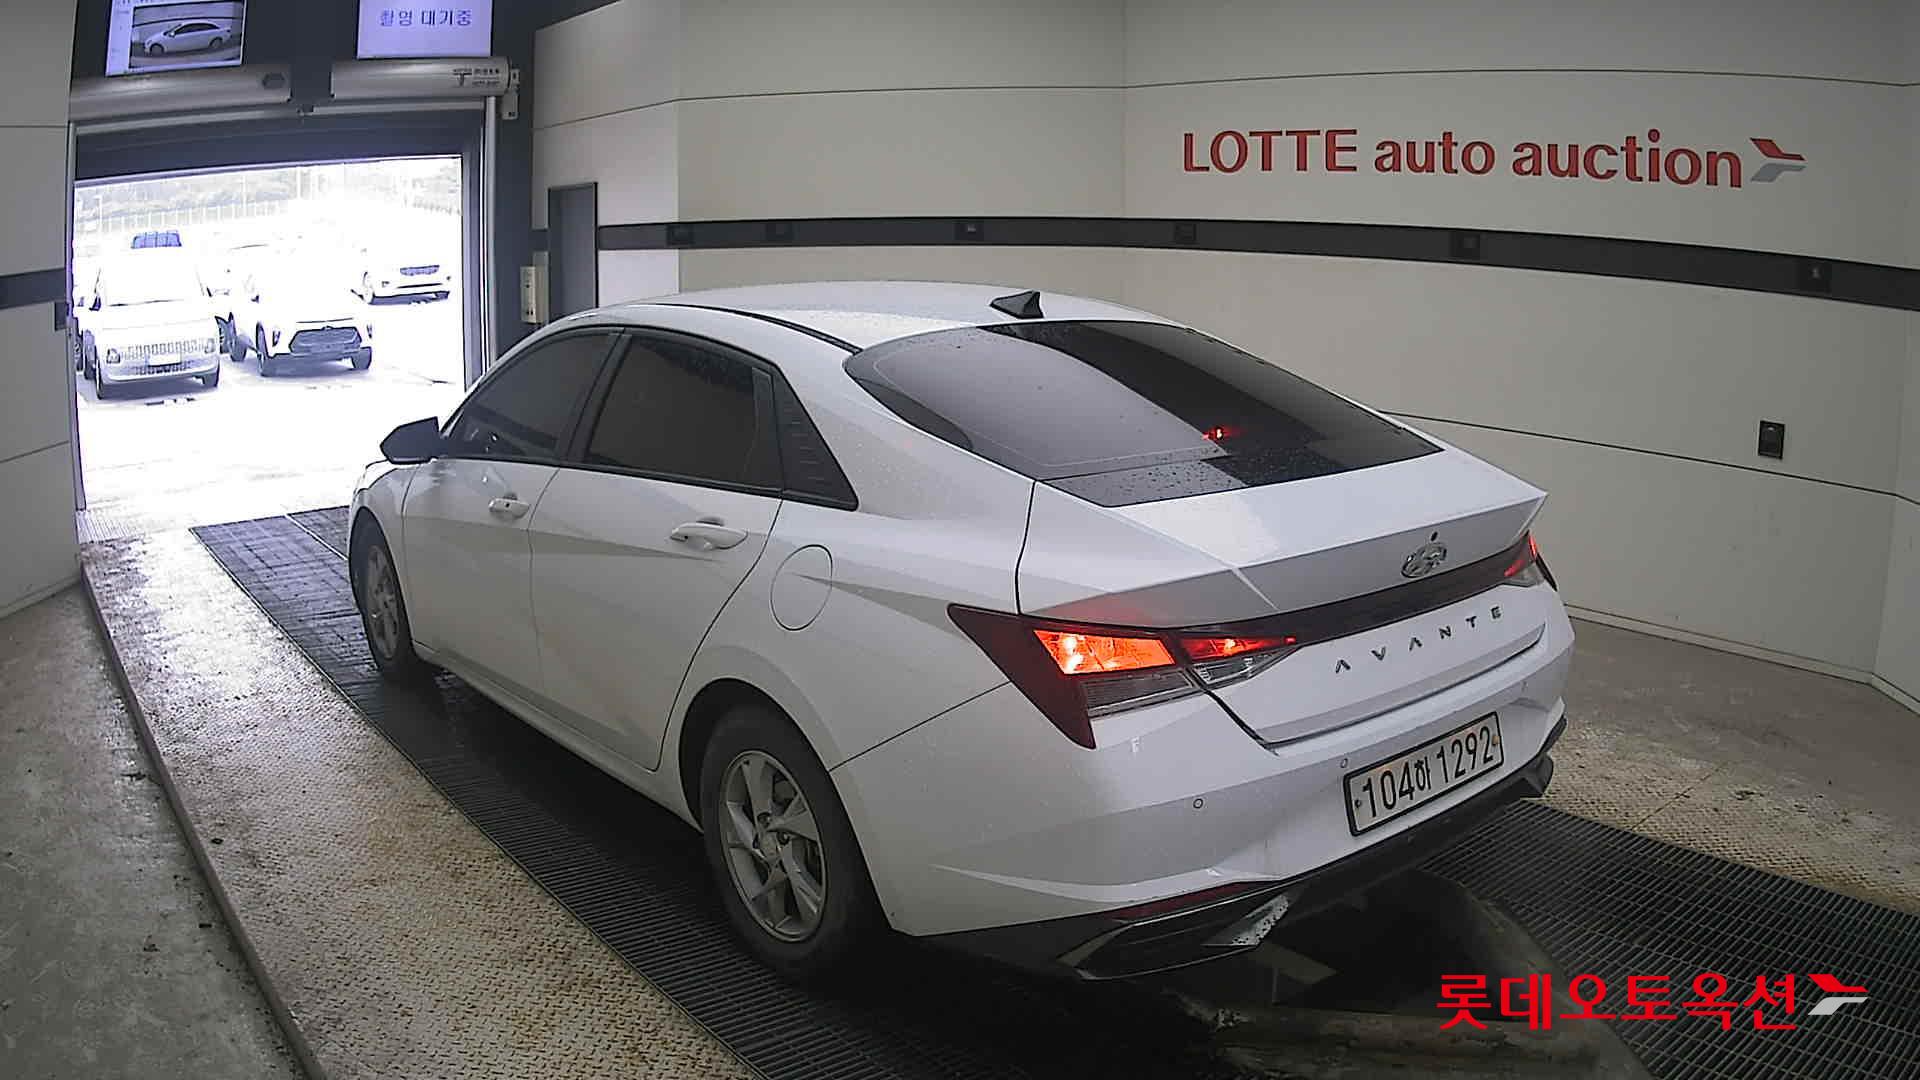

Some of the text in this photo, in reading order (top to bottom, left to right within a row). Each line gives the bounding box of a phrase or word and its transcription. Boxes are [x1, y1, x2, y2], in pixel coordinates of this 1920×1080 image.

[421, 9, 472, 26] 대기중
[1184, 129, 1742, 188] LOTTE auto auction
[1335, 606, 1503, 674] AVANTE
[1362, 725, 1494, 818] 104하 1292
